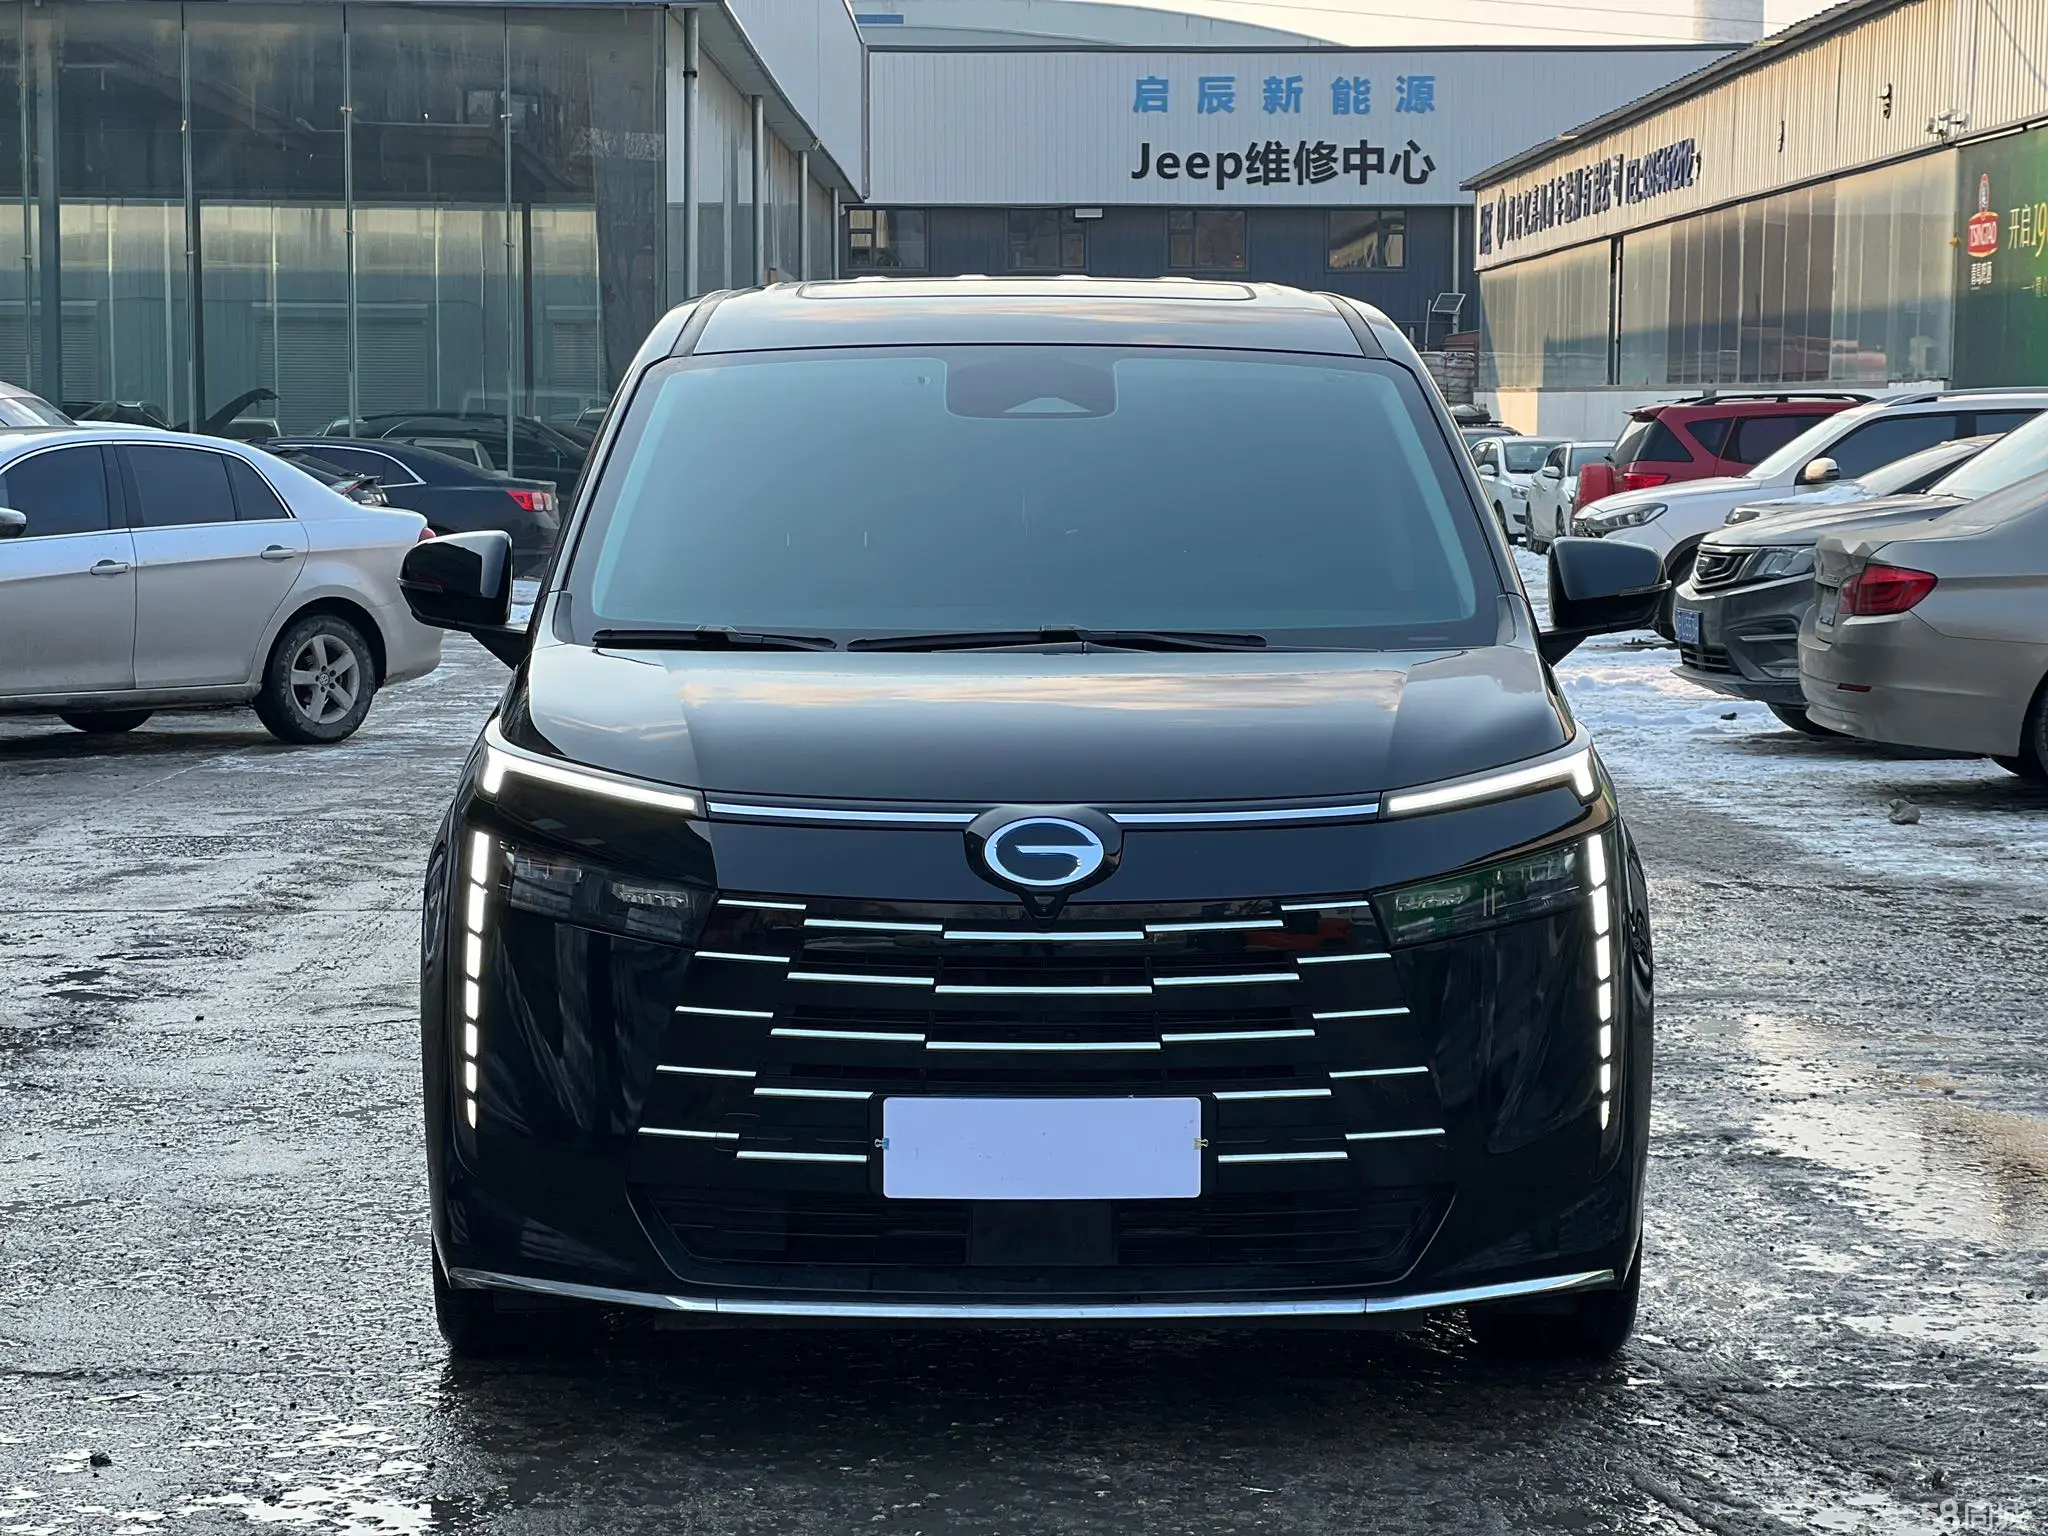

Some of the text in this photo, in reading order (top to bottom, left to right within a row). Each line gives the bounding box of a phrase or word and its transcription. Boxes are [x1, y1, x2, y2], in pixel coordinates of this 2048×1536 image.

[1132, 75, 1437, 115] 启辰新能源
[1131, 139, 1436, 190] Jeep维修中心
[2007, 201, 2048, 257] 开启19
